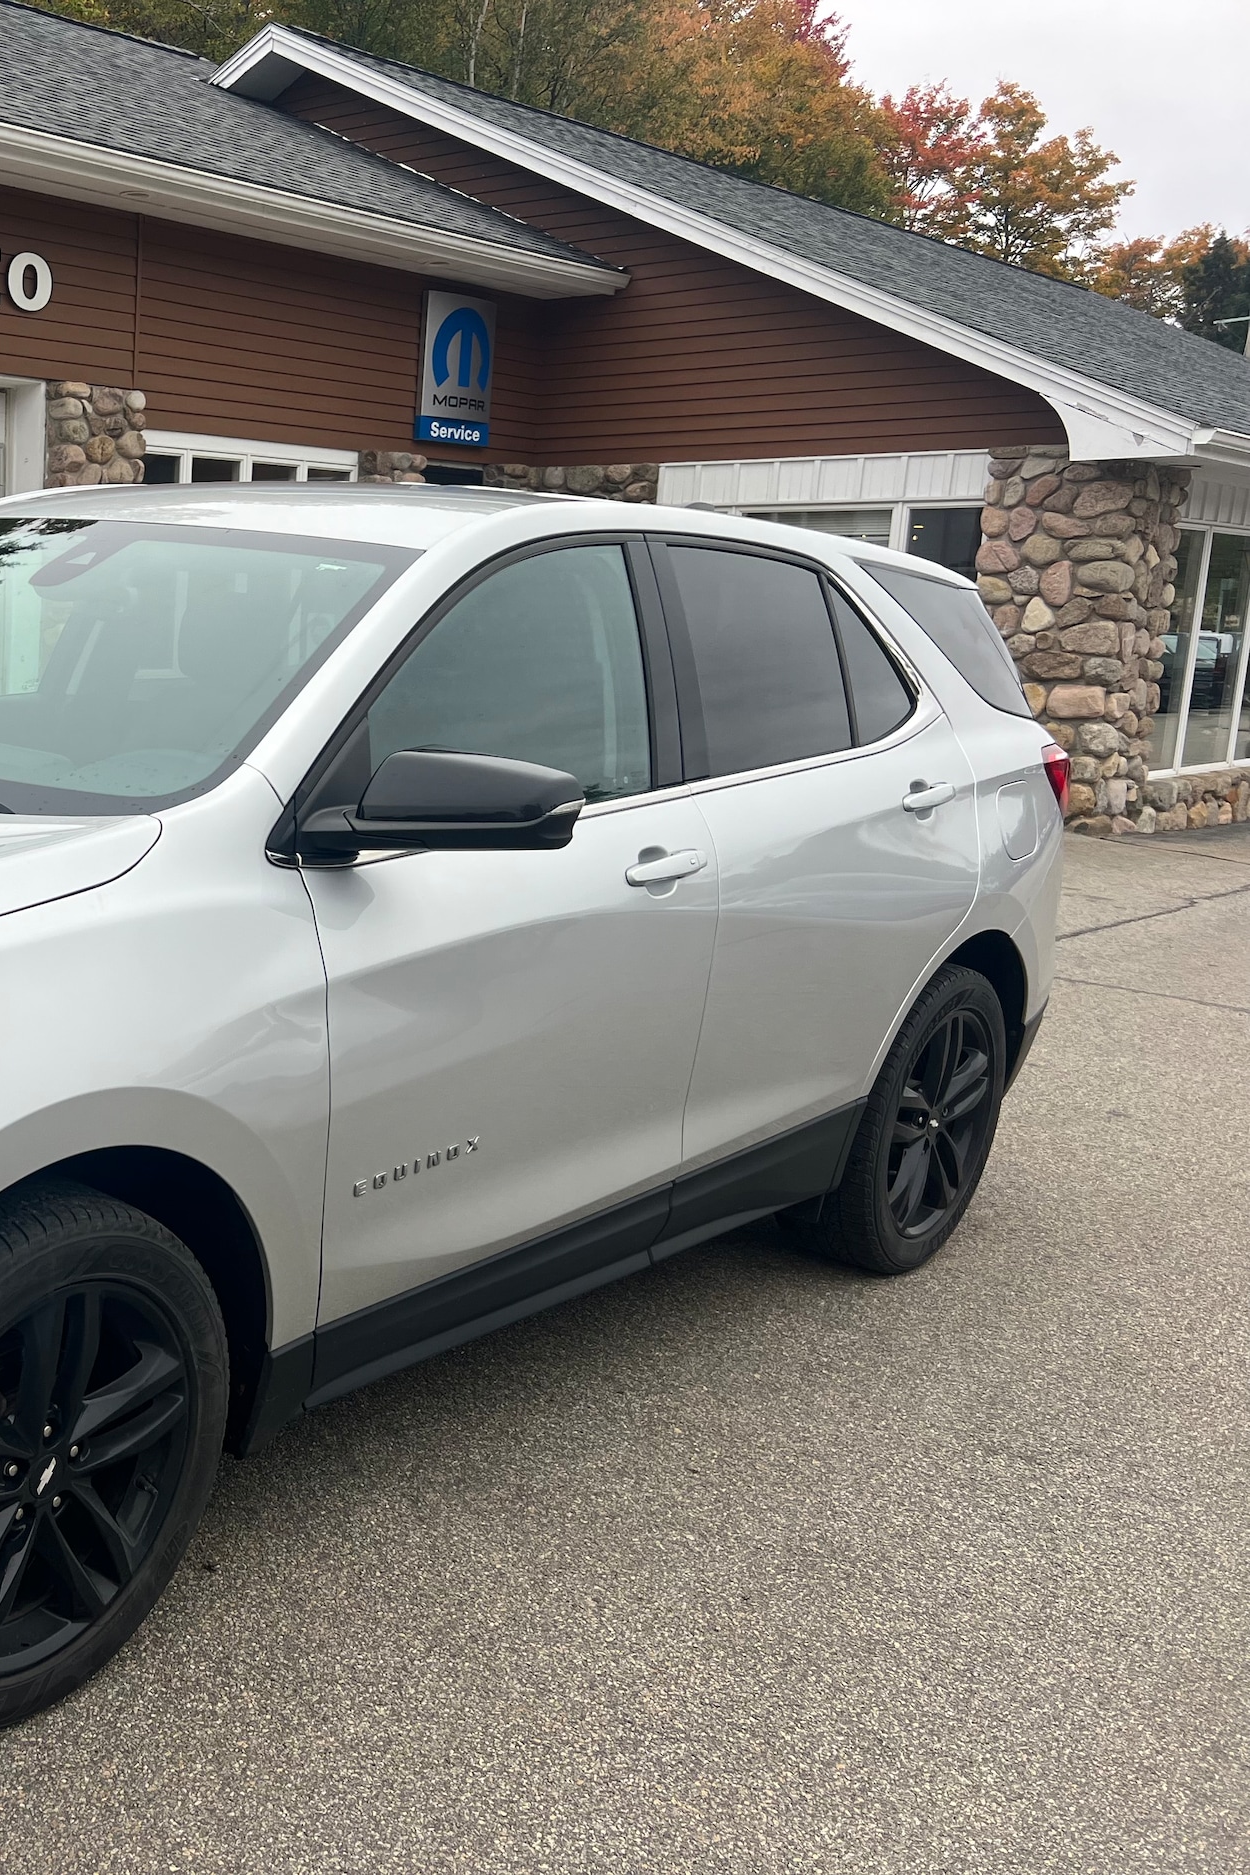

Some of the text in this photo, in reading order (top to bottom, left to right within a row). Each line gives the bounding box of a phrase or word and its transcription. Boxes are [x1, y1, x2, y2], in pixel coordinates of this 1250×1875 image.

[432, 393, 486, 412] MOPAR
[430, 421, 481, 442] Service
[352, 1135, 480, 1198] EQUINOX
